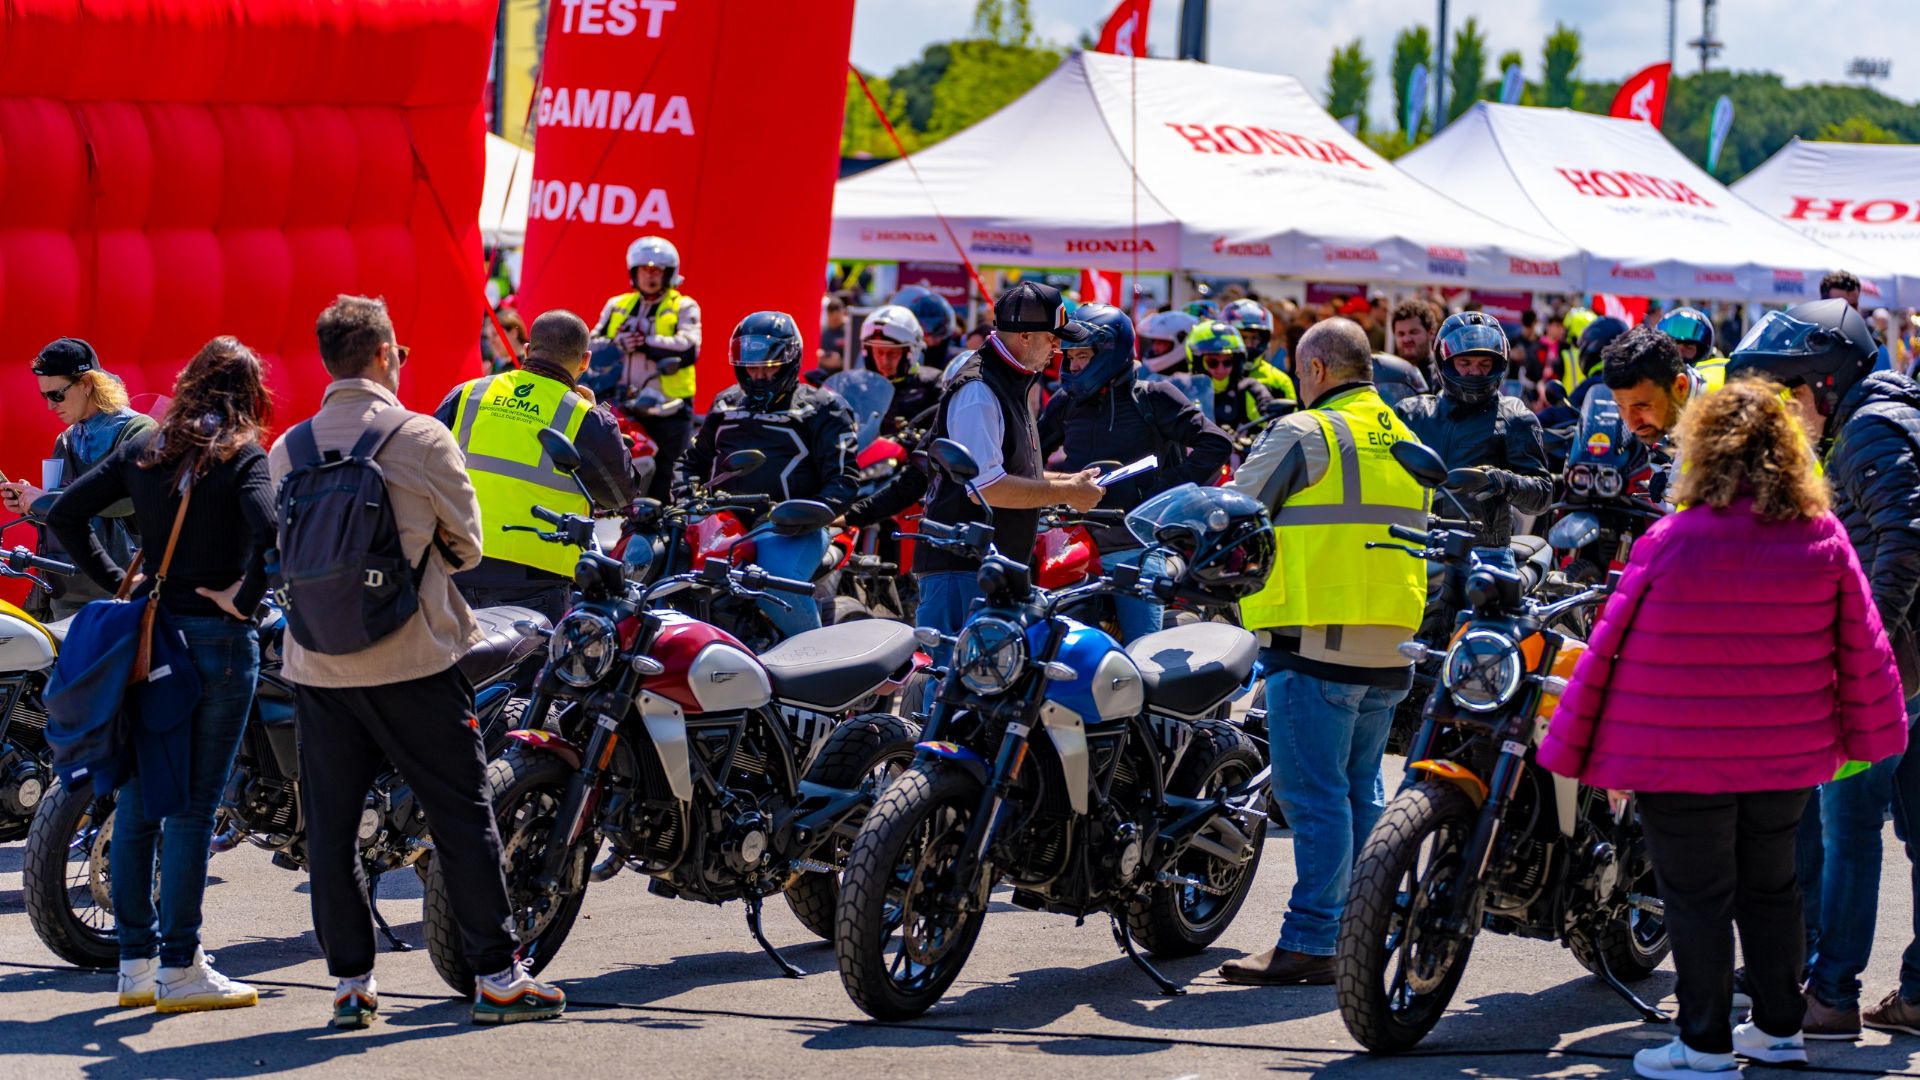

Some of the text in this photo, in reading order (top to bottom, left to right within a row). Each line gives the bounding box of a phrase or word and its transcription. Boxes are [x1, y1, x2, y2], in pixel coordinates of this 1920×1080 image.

[560, 0, 677, 38] TEST
[537, 86, 695, 135] GAMMA
[1163, 122, 1375, 170] HONDA
[1554, 167, 1717, 208] HONDA
[528, 178, 675, 229] HONDA
[876, 229, 938, 244] HONDA
[972, 229, 1032, 244] HONDA
[1067, 238, 1157, 253] HONDA
[1509, 257, 1561, 276] HONDA
[493, 396, 540, 415] EICMA
